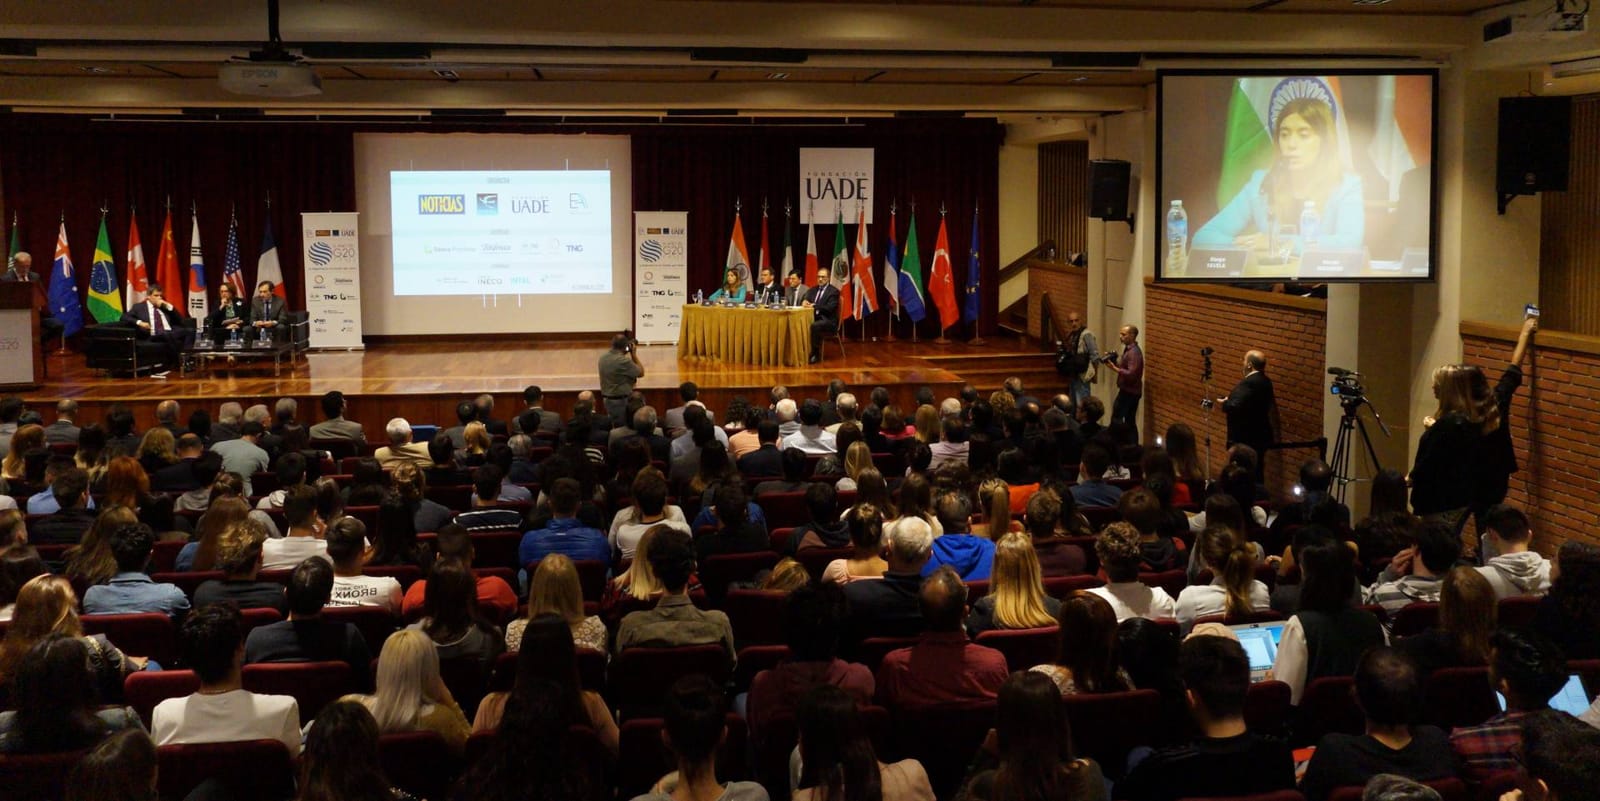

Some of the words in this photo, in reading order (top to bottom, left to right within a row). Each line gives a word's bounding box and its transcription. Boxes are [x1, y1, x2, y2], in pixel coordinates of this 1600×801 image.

[806, 178, 869, 200] UADE
[511, 200, 552, 214] UADE
[334, 248, 355, 258] G20
